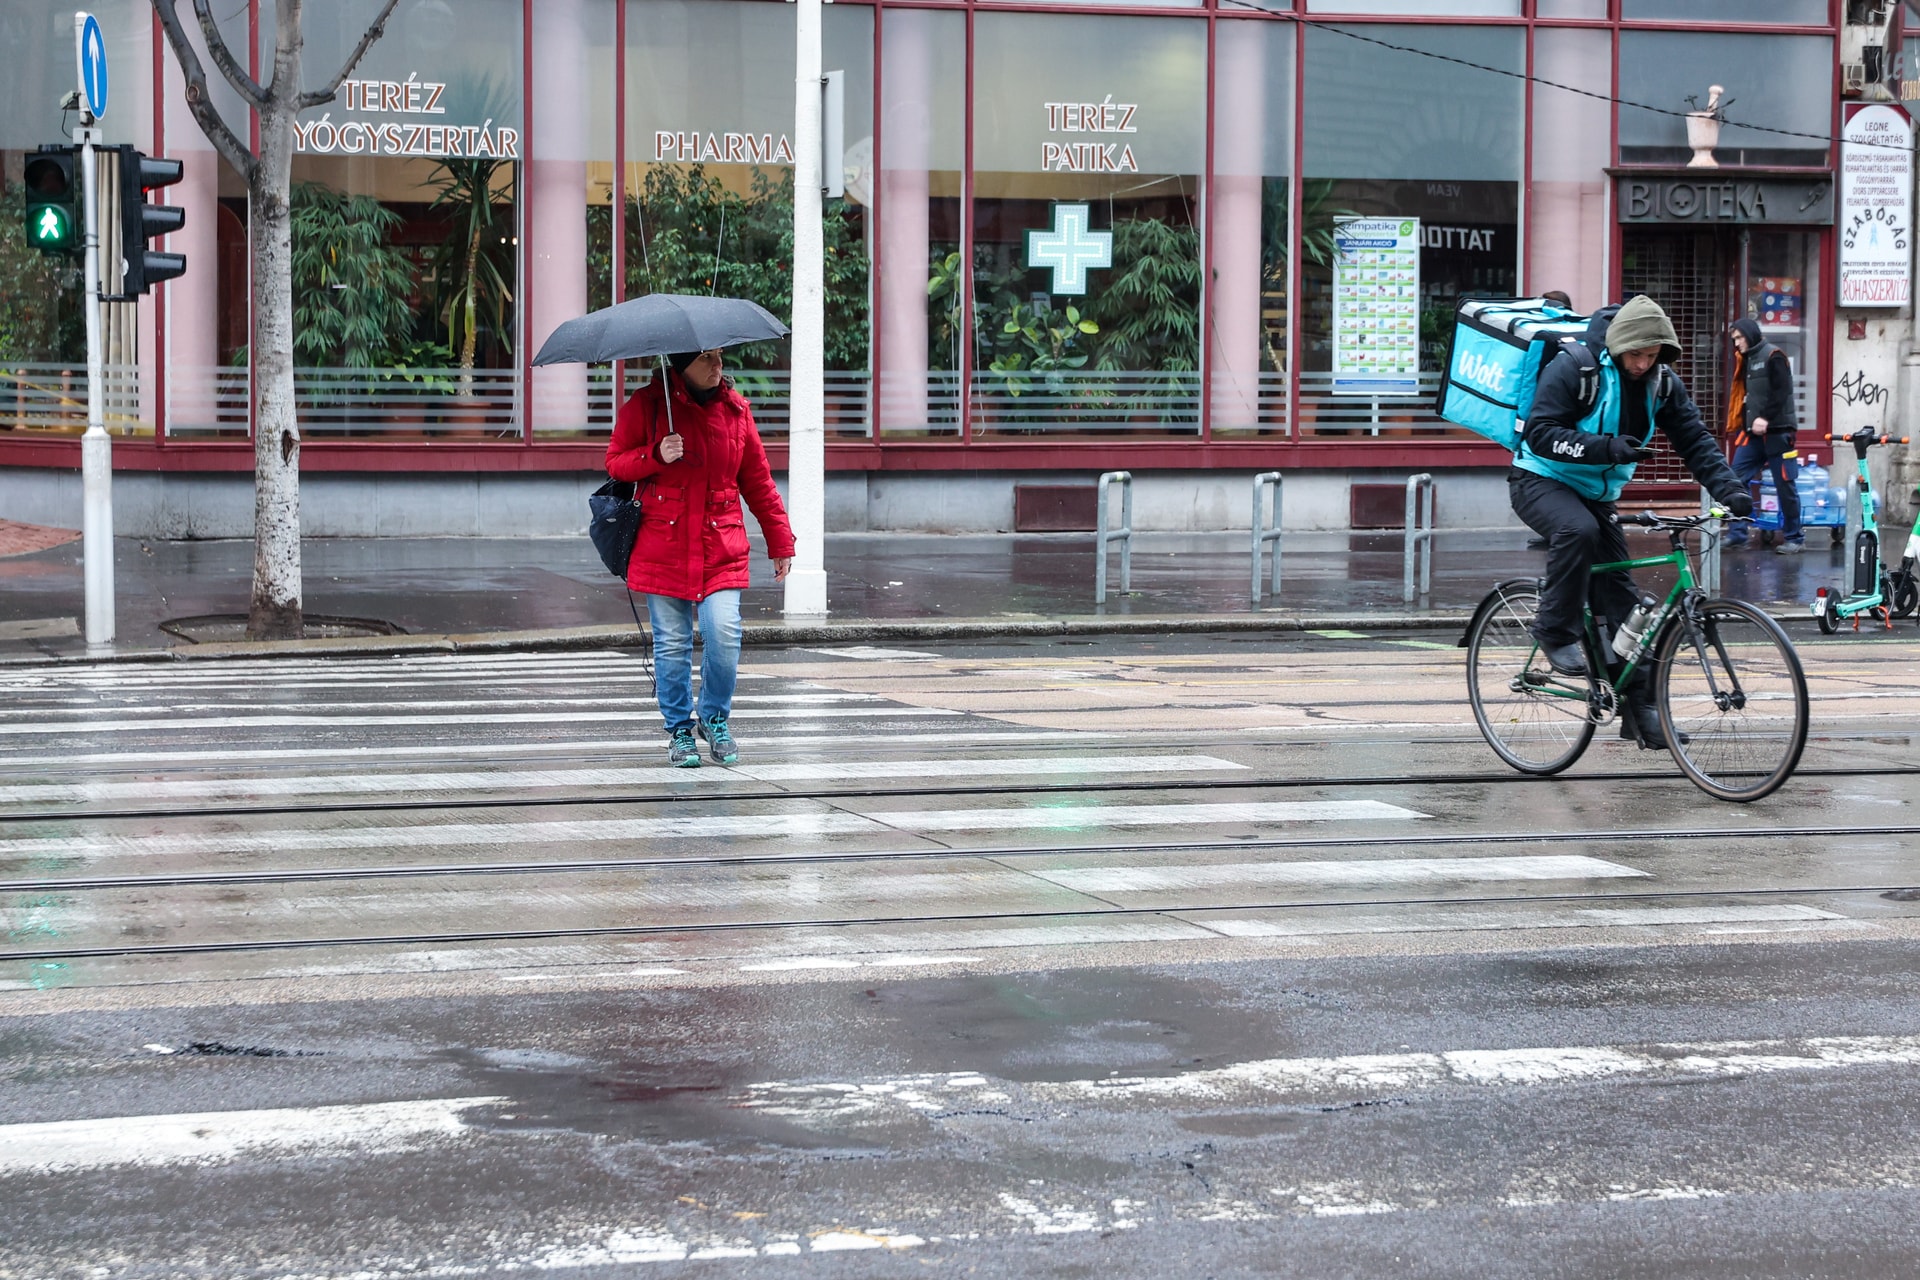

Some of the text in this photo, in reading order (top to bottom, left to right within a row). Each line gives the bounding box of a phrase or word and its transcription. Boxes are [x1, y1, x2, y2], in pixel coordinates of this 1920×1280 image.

[343, 72, 446, 114] TERÉZ
[1044, 94, 1138, 133] TERÉZ
[1864, 122, 1889, 132] LEONE
[294, 113, 518, 158] YÓGYSZERTÁR
[655, 131, 795, 164] PHARMA
[1850, 134, 1904, 145] SZOLGÁLTATÁS
[1042, 142, 1139, 172] PATIKA
[1628, 178, 1767, 219] BIOTÉKA
[1458, 350, 1506, 392] Wolt
[1552, 440, 1585, 458] Wolt
